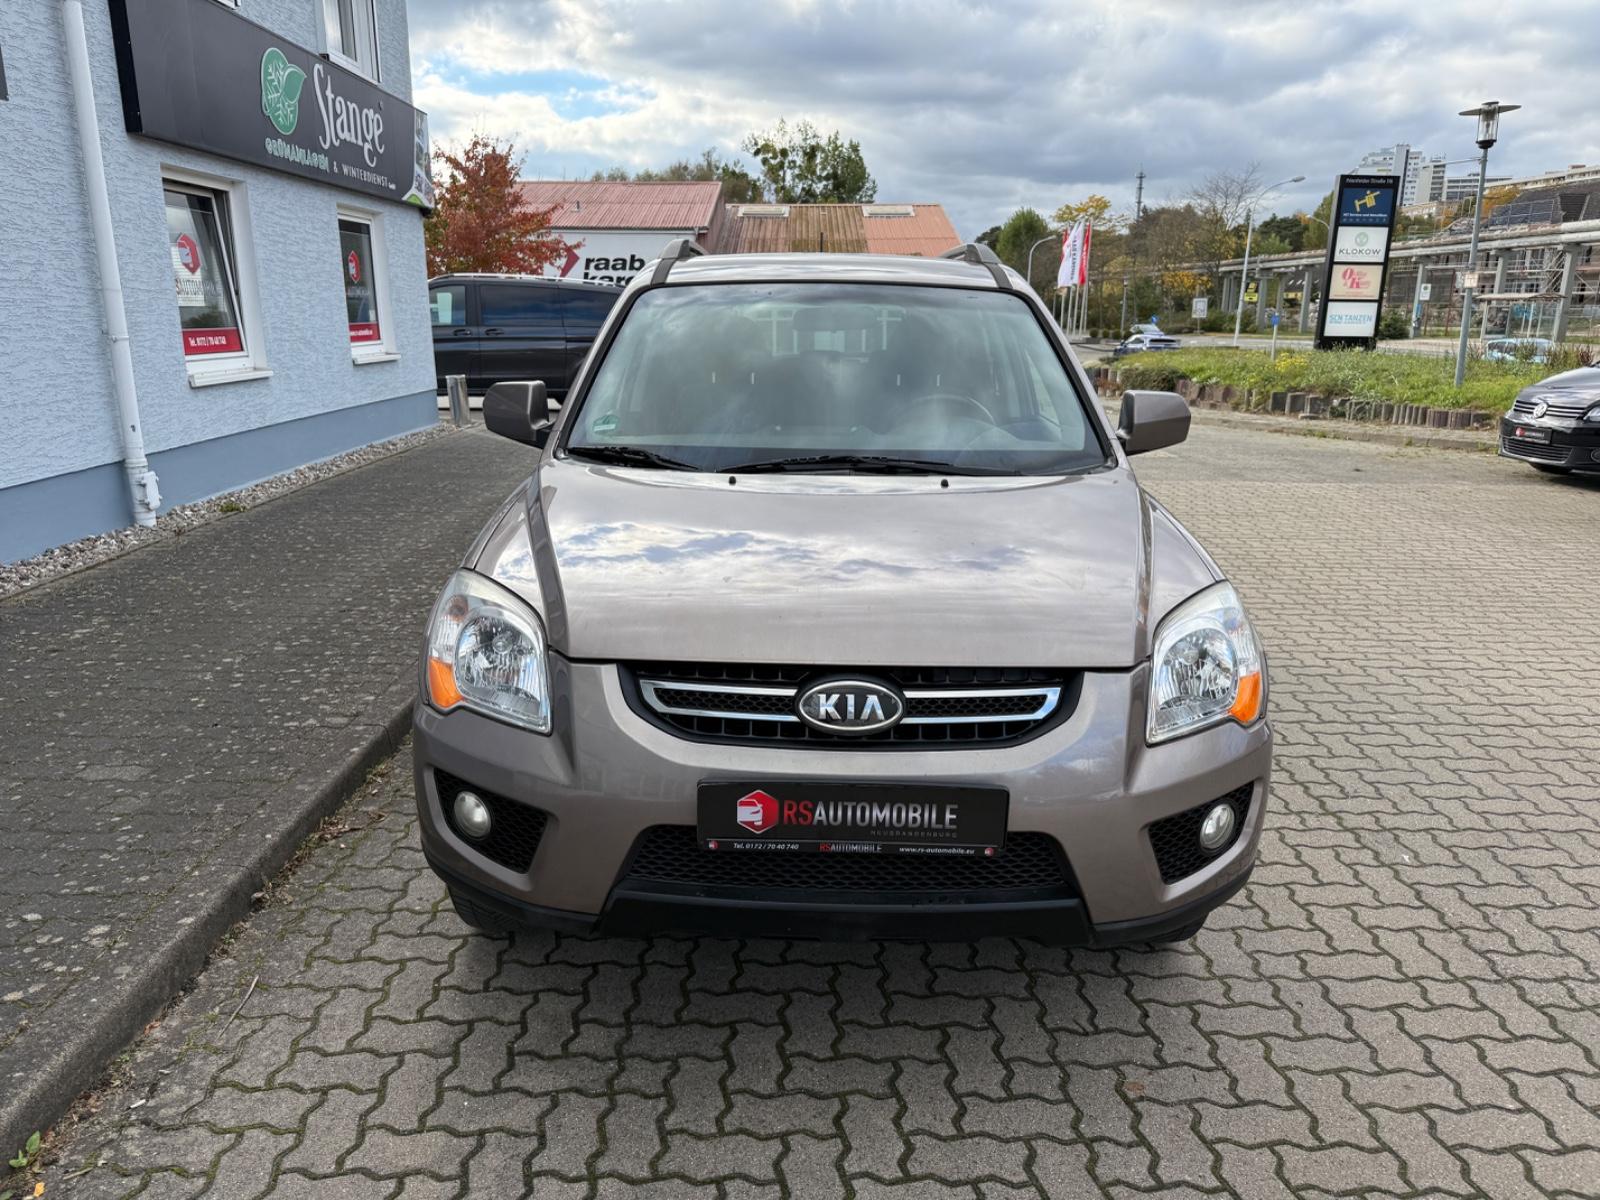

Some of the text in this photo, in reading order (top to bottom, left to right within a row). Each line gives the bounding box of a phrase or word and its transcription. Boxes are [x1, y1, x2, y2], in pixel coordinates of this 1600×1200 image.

[313, 63, 385, 168] Stange
[333, 160, 338, 173] &
[341, 163, 388, 187] WINTERDIENST
[584, 254, 646, 271] raab
[816, 693, 886, 721] KIA
[783, 800, 959, 829] RSAUTOMOBILE
[819, 843, 883, 853] RSAUTOMOBILE
[899, 847, 975, 855] www.rs-automobile.eu
